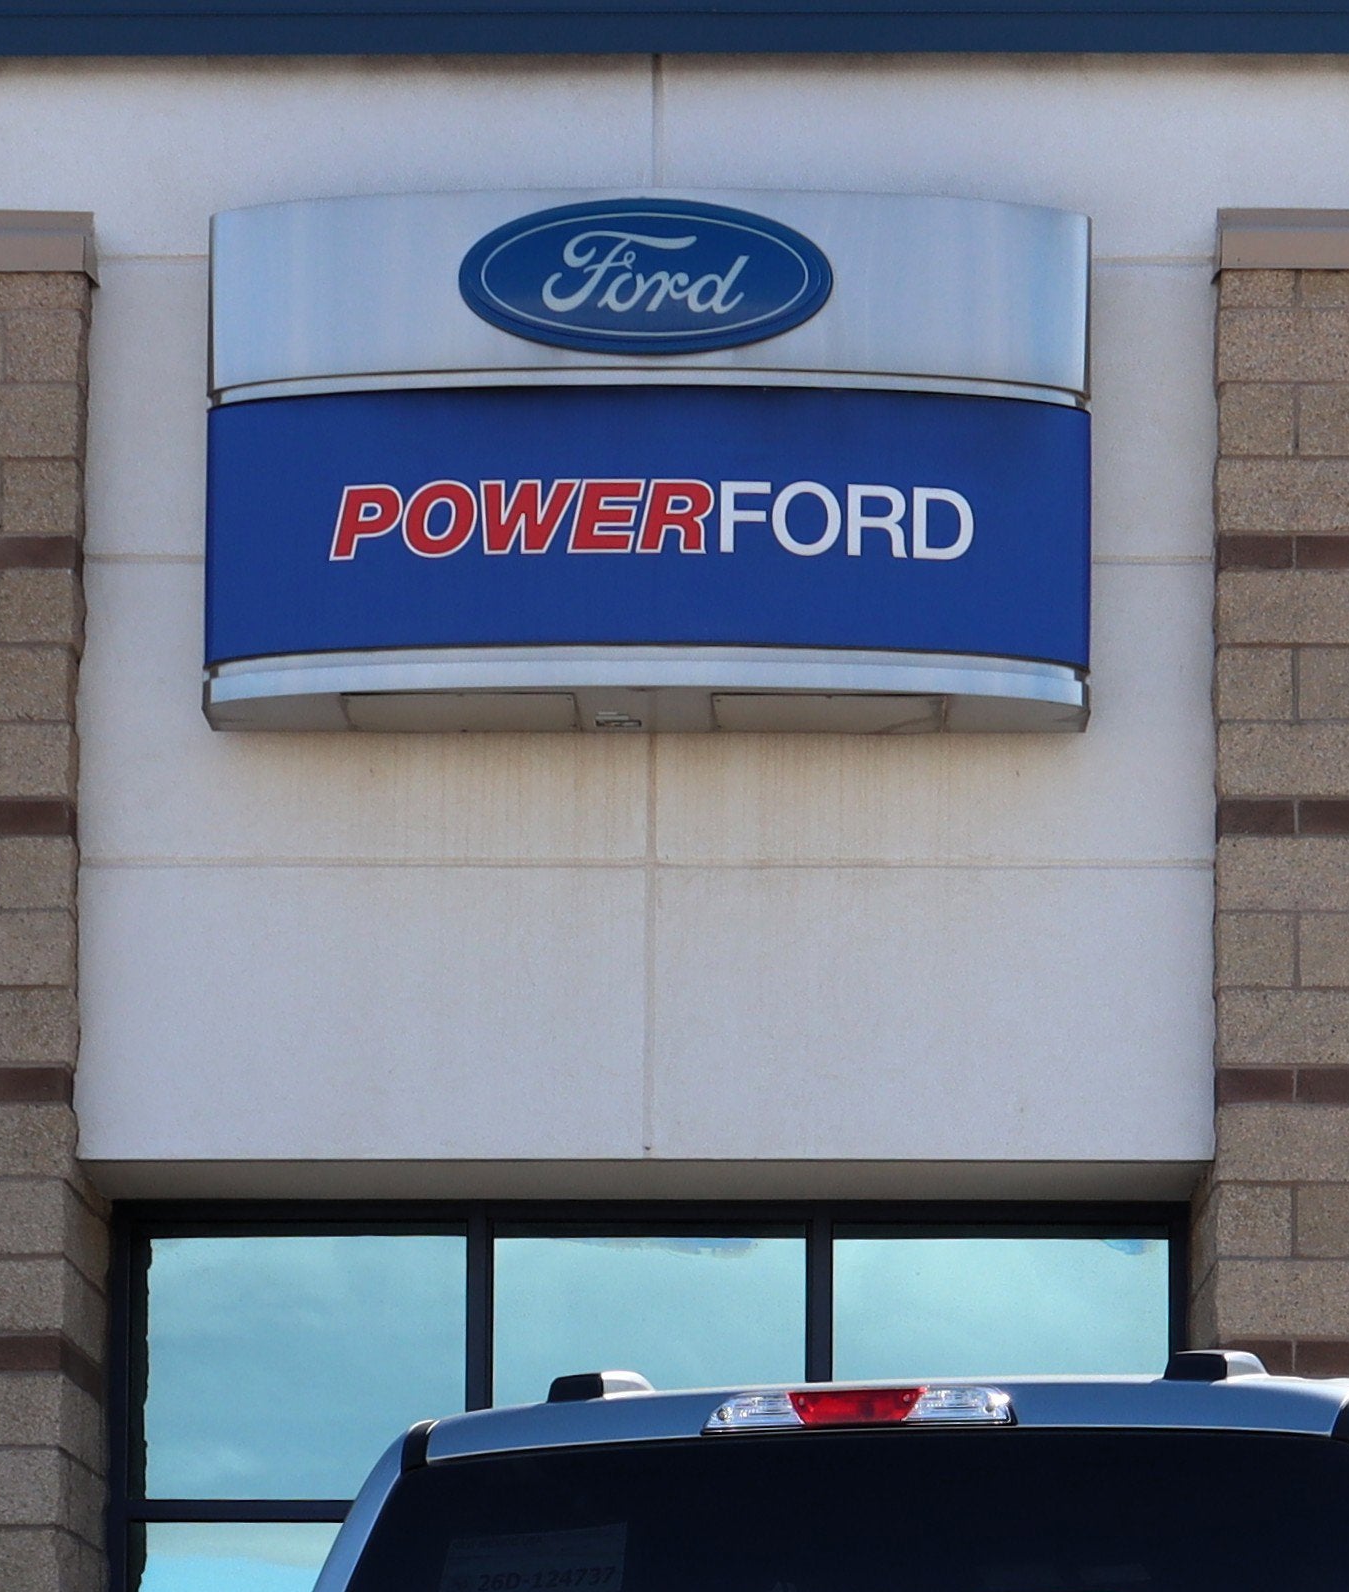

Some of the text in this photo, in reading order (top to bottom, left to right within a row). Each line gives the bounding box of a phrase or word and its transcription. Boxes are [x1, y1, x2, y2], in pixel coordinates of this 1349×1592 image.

[540, 230, 749, 316] Ford
[329, 478, 975, 561] POWERFORD
[477, 1565, 616, 1592] 26D-124737
